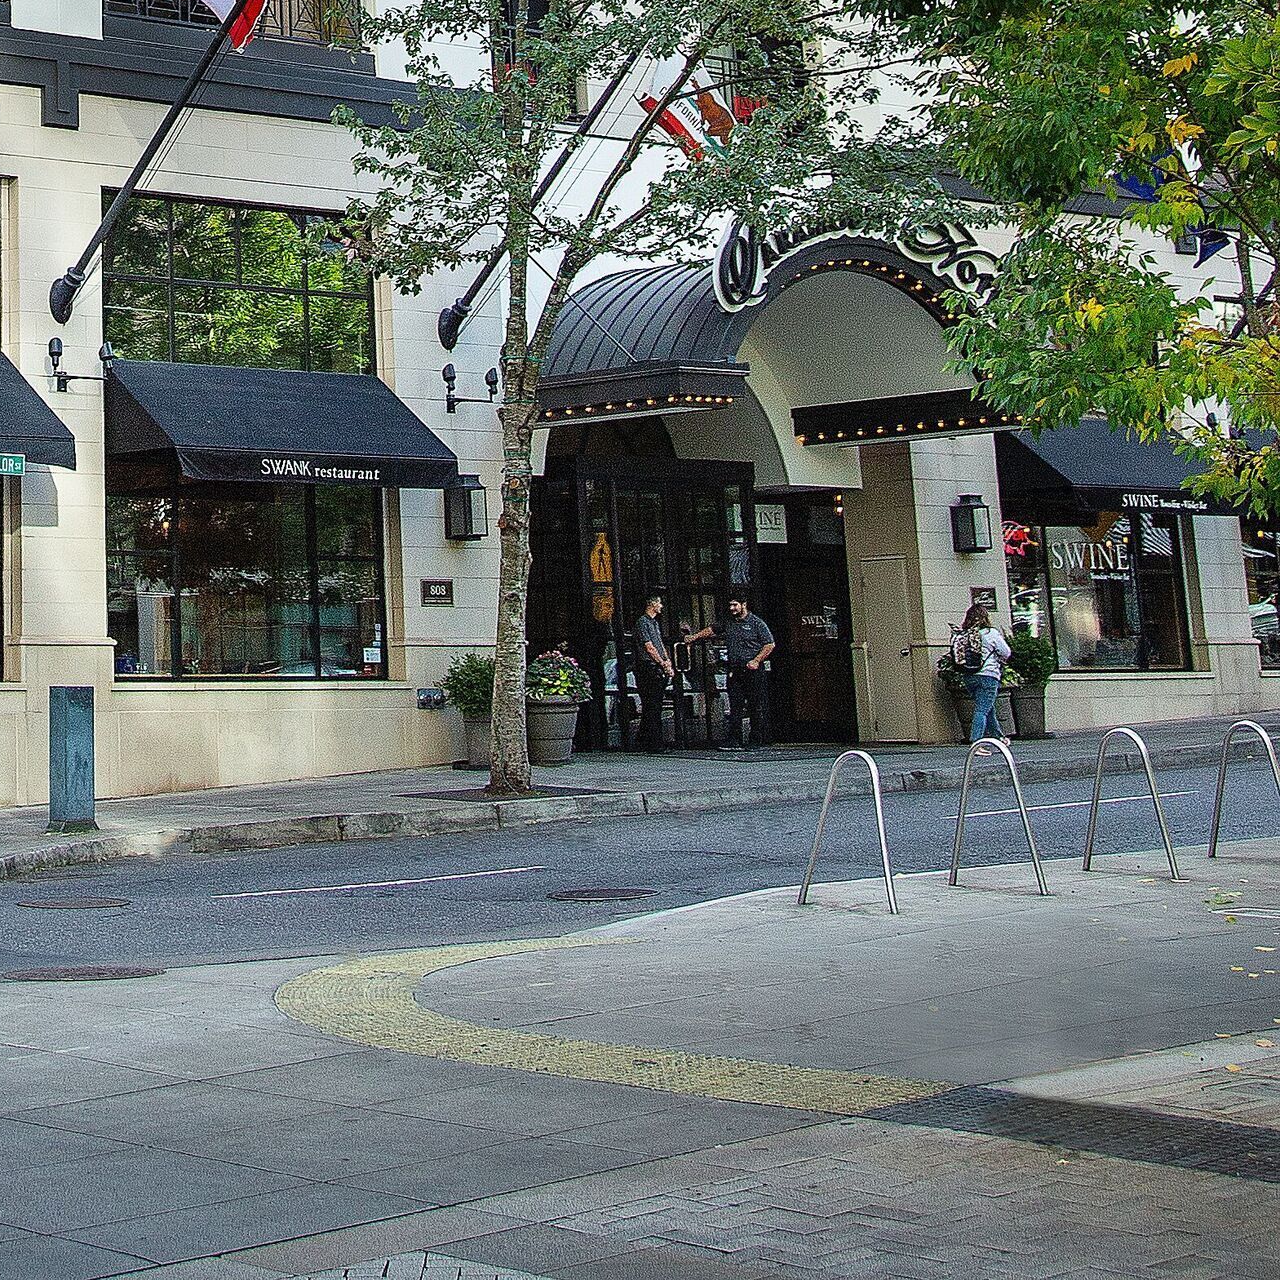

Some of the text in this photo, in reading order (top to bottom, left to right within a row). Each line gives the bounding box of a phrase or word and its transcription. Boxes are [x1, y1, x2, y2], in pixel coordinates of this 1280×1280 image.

[659, 86, 703, 134] CIFORNIA
[14, 462, 22, 471] ST
[261, 459, 380, 480] SWANK restaurant
[1122, 494, 1159, 508] SWINE
[1052, 542, 1130, 570] SWINE
